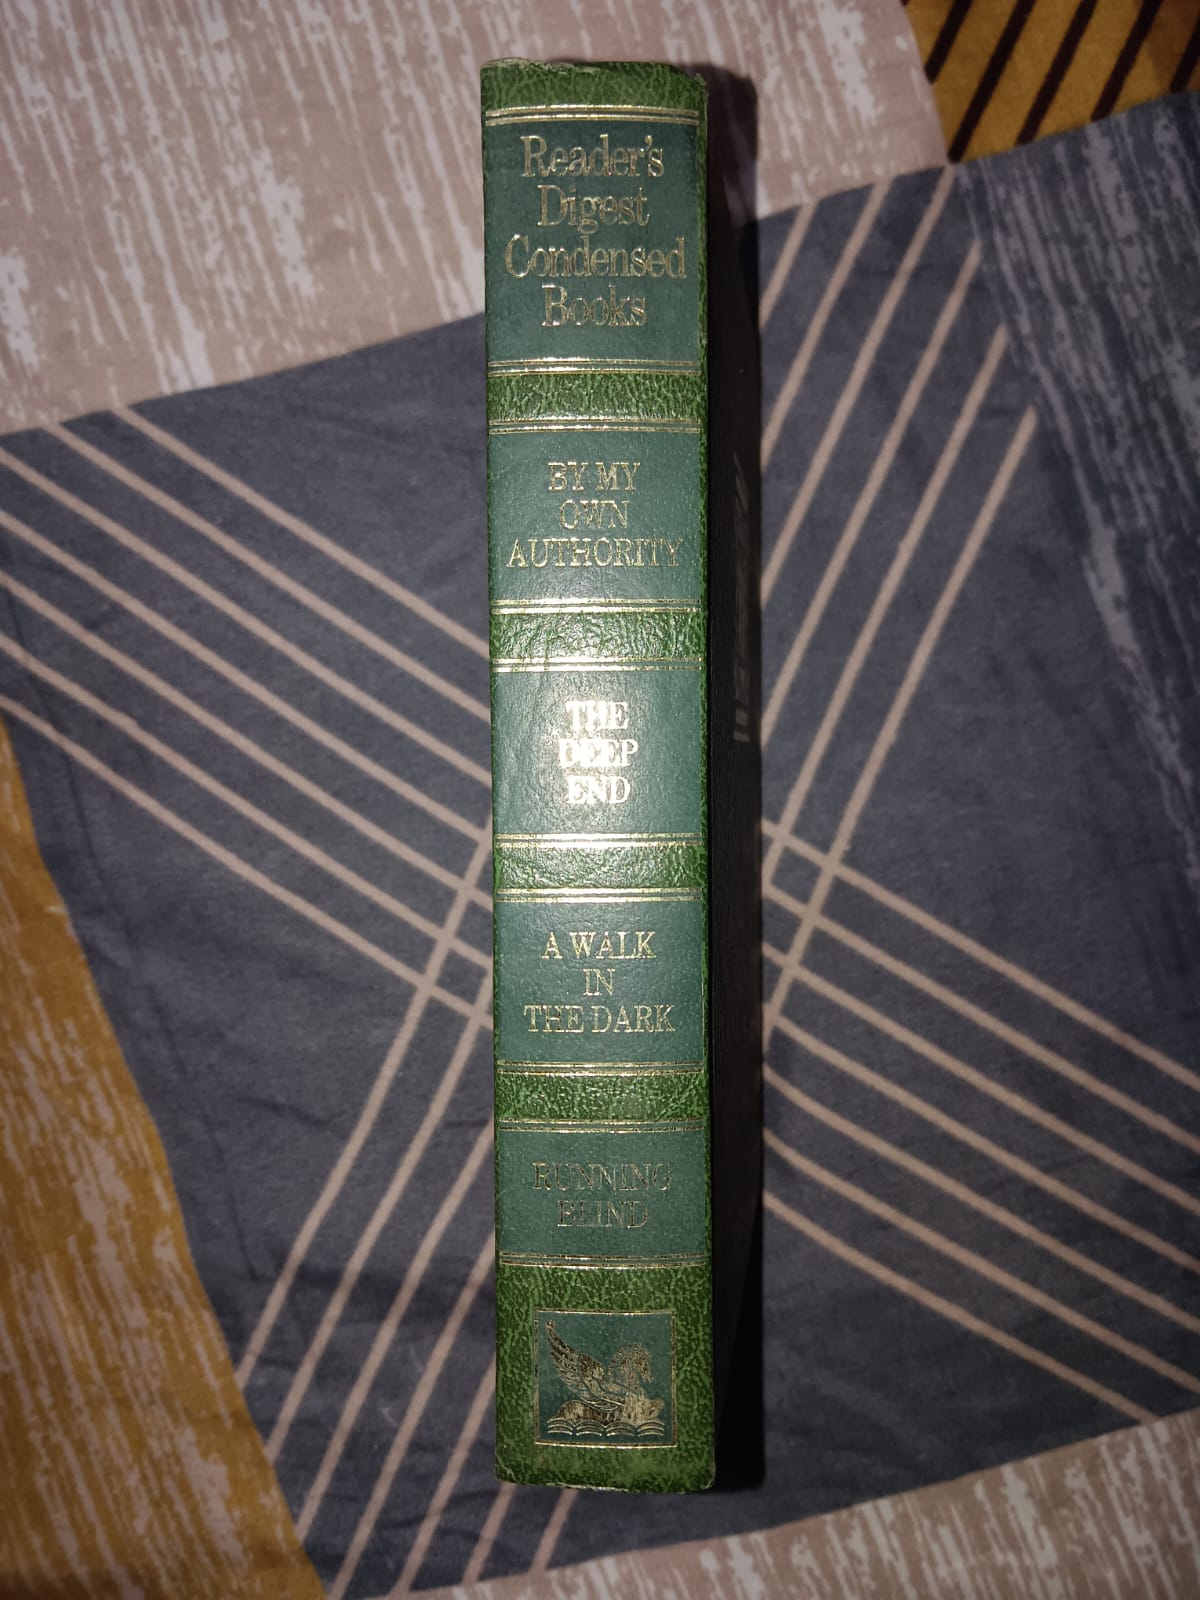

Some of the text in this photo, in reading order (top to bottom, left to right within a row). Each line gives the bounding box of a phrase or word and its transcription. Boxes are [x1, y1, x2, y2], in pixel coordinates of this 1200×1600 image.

[520, 133, 665, 177] Reader's
[537, 184, 650, 234] Digest
[505, 234, 687, 279] Condensed
[542, 284, 647, 327] Books
[548, 462, 641, 491] BY MY
[560, 499, 630, 529] OWN
[506, 537, 684, 568] AUTHORITY
[566, 700, 629, 730] THE
[559, 738, 639, 768] DEEP
[566, 775, 631, 804] END
[541, 931, 657, 960] A WALK
[583, 968, 616, 997] IN
[523, 1004, 676, 1033] THE DARK
[532, 1162, 672, 1192] RUNNING
[557, 1200, 648, 1229] BLIND
